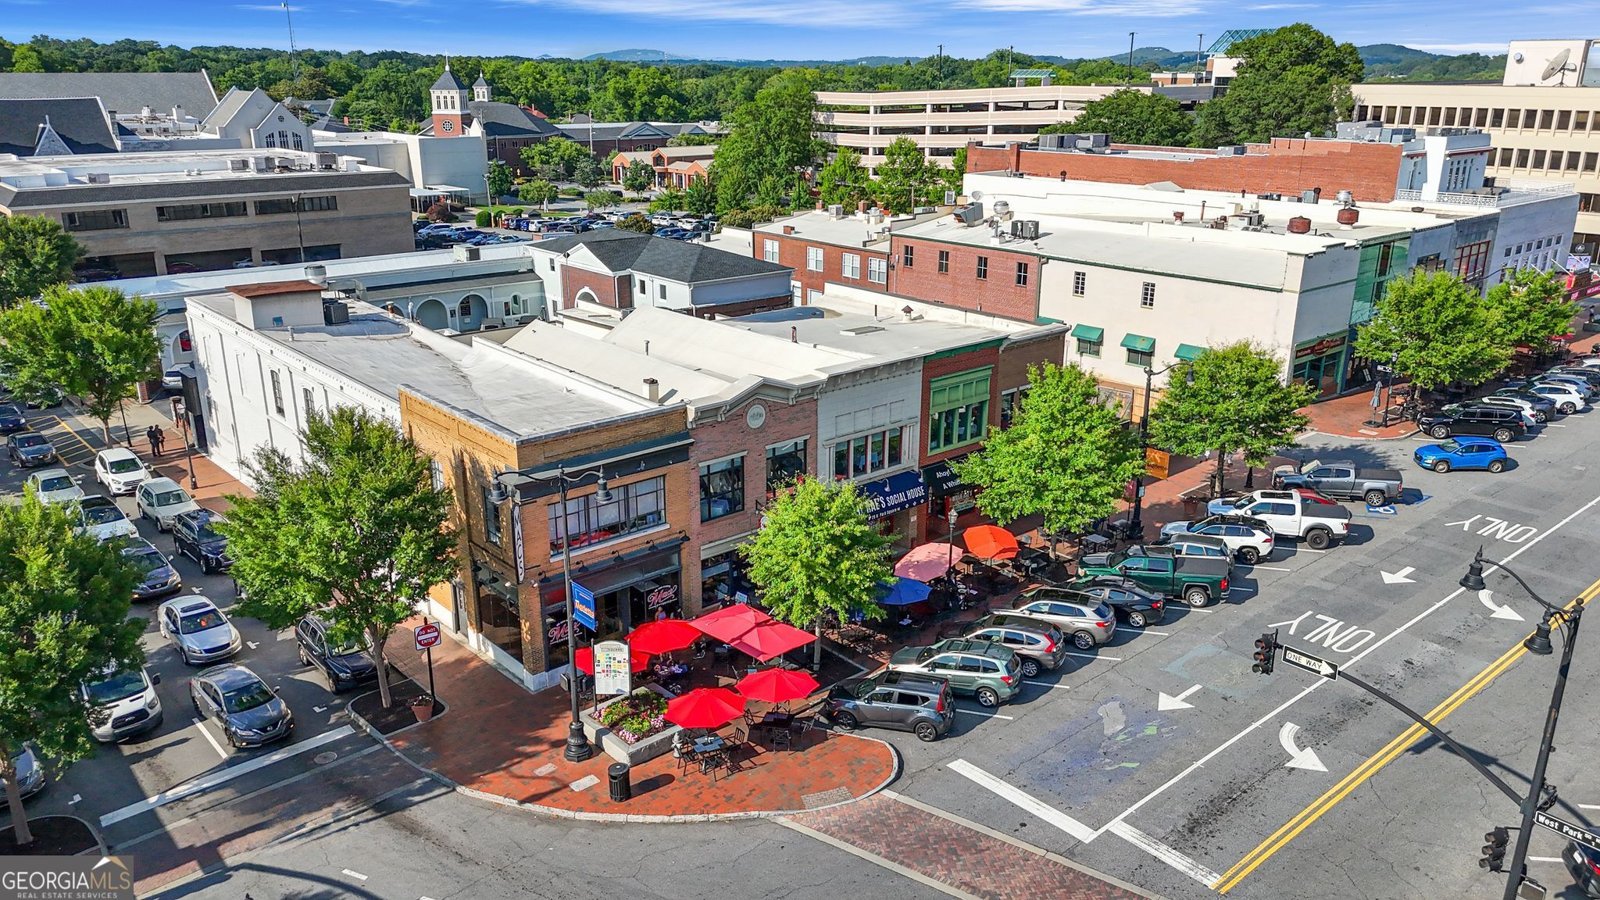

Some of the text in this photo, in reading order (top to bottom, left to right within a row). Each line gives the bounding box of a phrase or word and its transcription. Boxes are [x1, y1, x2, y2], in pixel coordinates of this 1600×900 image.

[886, 491, 907, 506] SOCIAL
[906, 486, 925, 500] HOUSE
[1444, 514, 1538, 543] ONLY
[1267, 610, 1376, 653] ONLY
[1287, 652, 1322, 669] ONE WAY
[1538, 814, 1559, 829] West
[1563, 825, 1583, 840] Park
